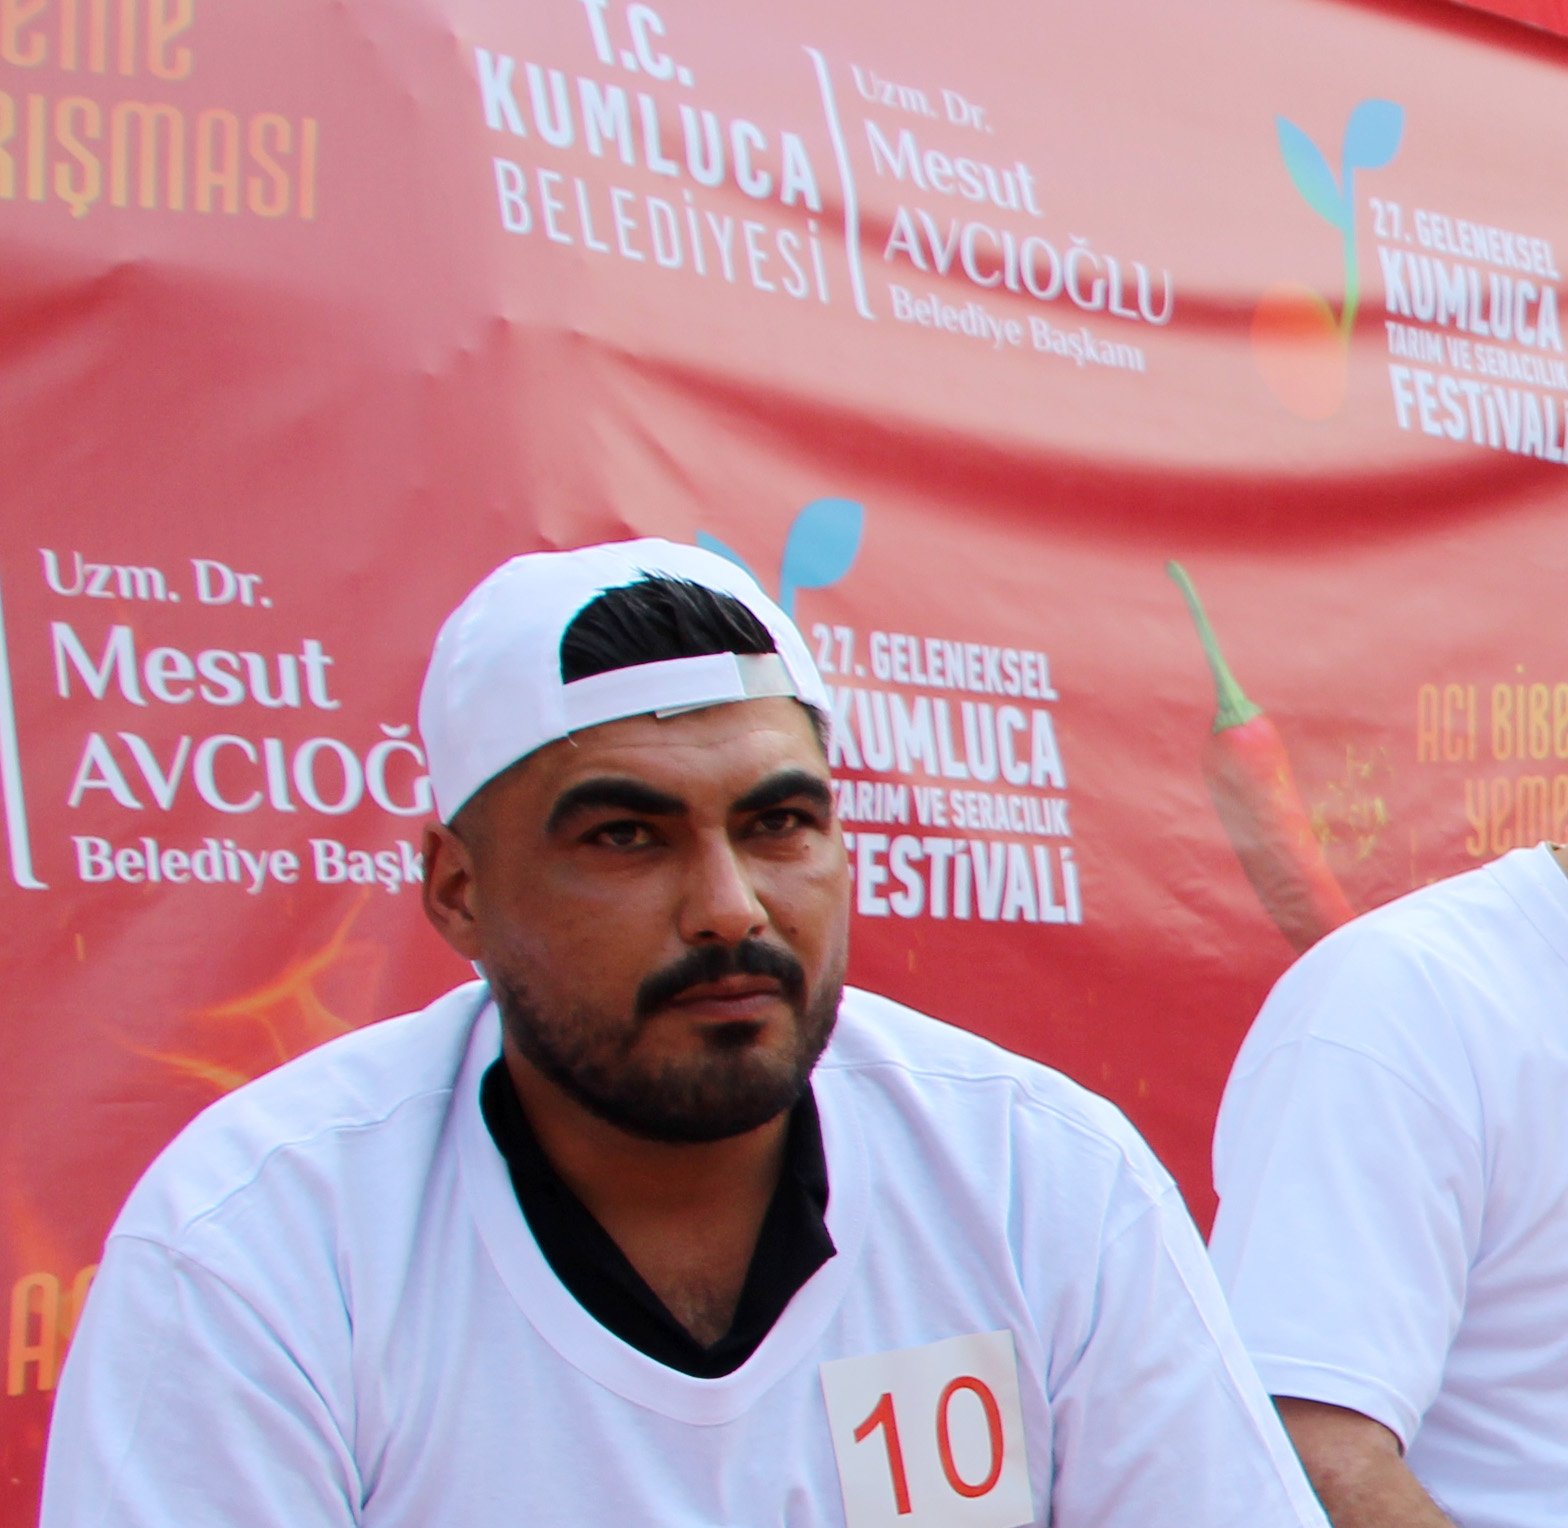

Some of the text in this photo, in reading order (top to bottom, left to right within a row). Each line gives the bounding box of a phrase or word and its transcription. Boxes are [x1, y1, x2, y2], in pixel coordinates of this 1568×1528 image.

[474, 46, 821, 211] KUMLUCA
[849, 64, 994, 134] Uzm. Dr.
[863, 119, 1044, 217] Mesut
[493, 157, 829, 305] BELEDİYESİ
[883, 205, 1174, 326] AVCIOĞLU
[1369, 197, 1561, 281] 27. GELENEKSEL
[887, 284, 1147, 372] Belediye Başkanı
[1377, 245, 1564, 352] KUMLUCA
[1385, 320, 1443, 364] TARIM
[1446, 336, 1473, 372] VE
[40, 548, 274, 608] Uzm. Dr.
[50, 621, 342, 710] Mesut
[811, 622, 1060, 701] 27. GELENEKSEL
[827, 683, 1068, 789] KUMLUCA
[1416, 682, 1477, 763] ACI
[68, 723, 434, 817] AVCIOĞ
[911, 785, 948, 828] VE
[950, 790, 1072, 838] SERACILIK
[71, 835, 424, 894] Belediye Başk
[852, 1374, 1005, 1517] 10
